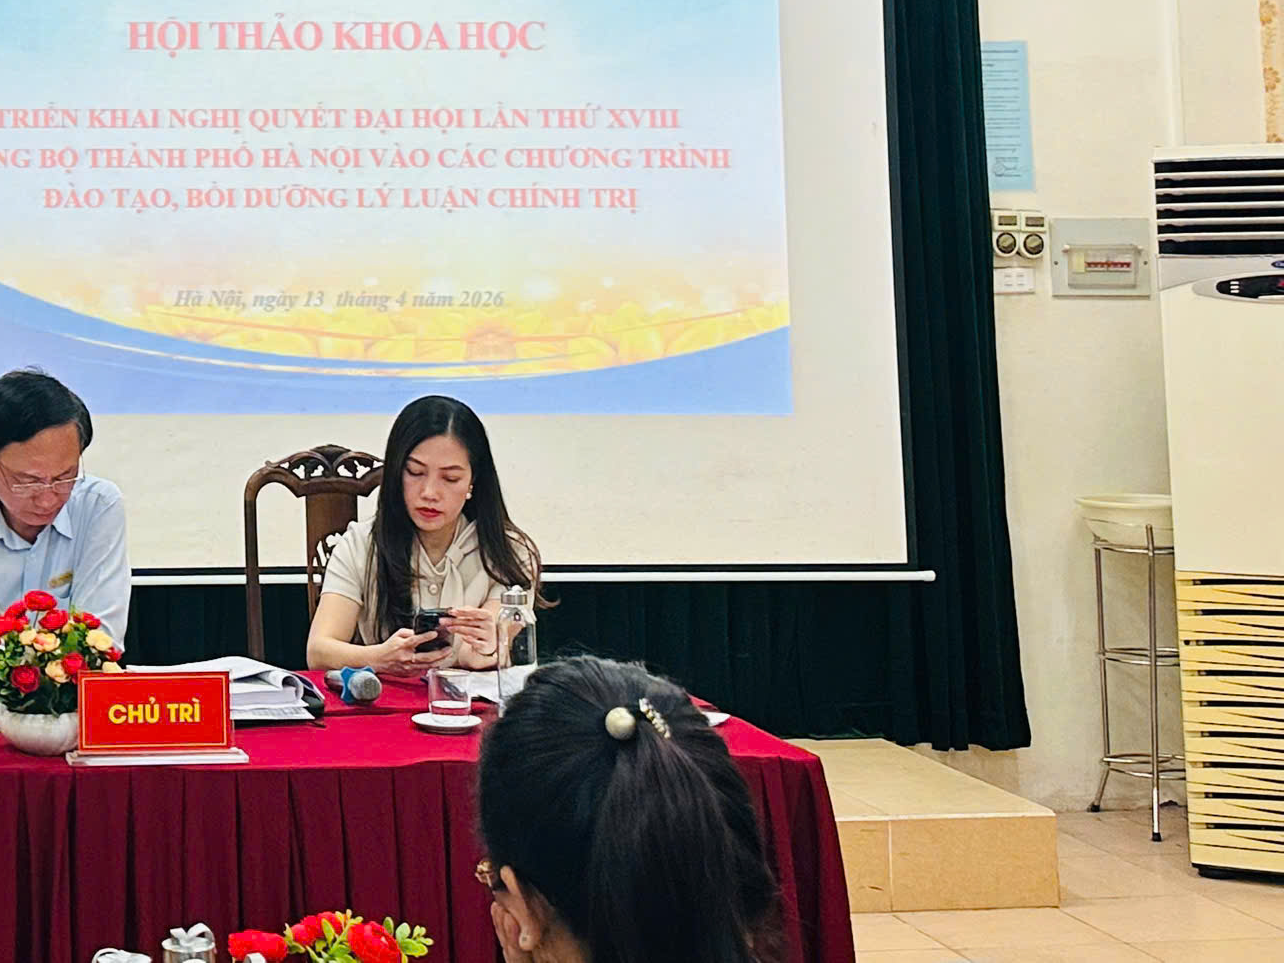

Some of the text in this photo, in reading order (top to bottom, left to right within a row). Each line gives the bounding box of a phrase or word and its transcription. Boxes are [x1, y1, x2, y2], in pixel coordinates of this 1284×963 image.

[126, 12, 547, 59] HỘI THẢO KHOA HỌC
[85, 108, 159, 129] KHAI
[168, 108, 241, 135] NGHỊ
[248, 101, 347, 134] QUYẾT
[355, 108, 403, 135] ĐẠI
[411, 105, 464, 135] HỘI
[472, 101, 530, 129] LẦN
[537, 102, 601, 129] THỨ
[606, 108, 683, 129] XVIII
[38, 146, 80, 175] BỘ
[86, 142, 187, 169] THÀNH
[194, 141, 254, 169] PHỐ
[261, 142, 303, 169] HÀ
[310, 145, 362, 175] NỘI
[369, 142, 431, 169] VÀO
[437, 142, 498, 169] CÁC
[504, 145, 633, 169] CHƯƠNG
[638, 142, 732, 169] TRÌNH
[43, 182, 104, 209] ĐÀO
[111, 188, 179, 214] TẠO,
[243, 184, 349, 209] DƯỠNG
[356, 182, 394, 209] LÝ
[402, 185, 479, 214] LUẬN
[487, 182, 581, 209] CHÍNH
[588, 188, 641, 215] TRỊ
[173, 289, 506, 313] Hà Nội, ngày 13 tháng 4 năm 2026
[108, 696, 201, 724] CHỦ TRÌ
